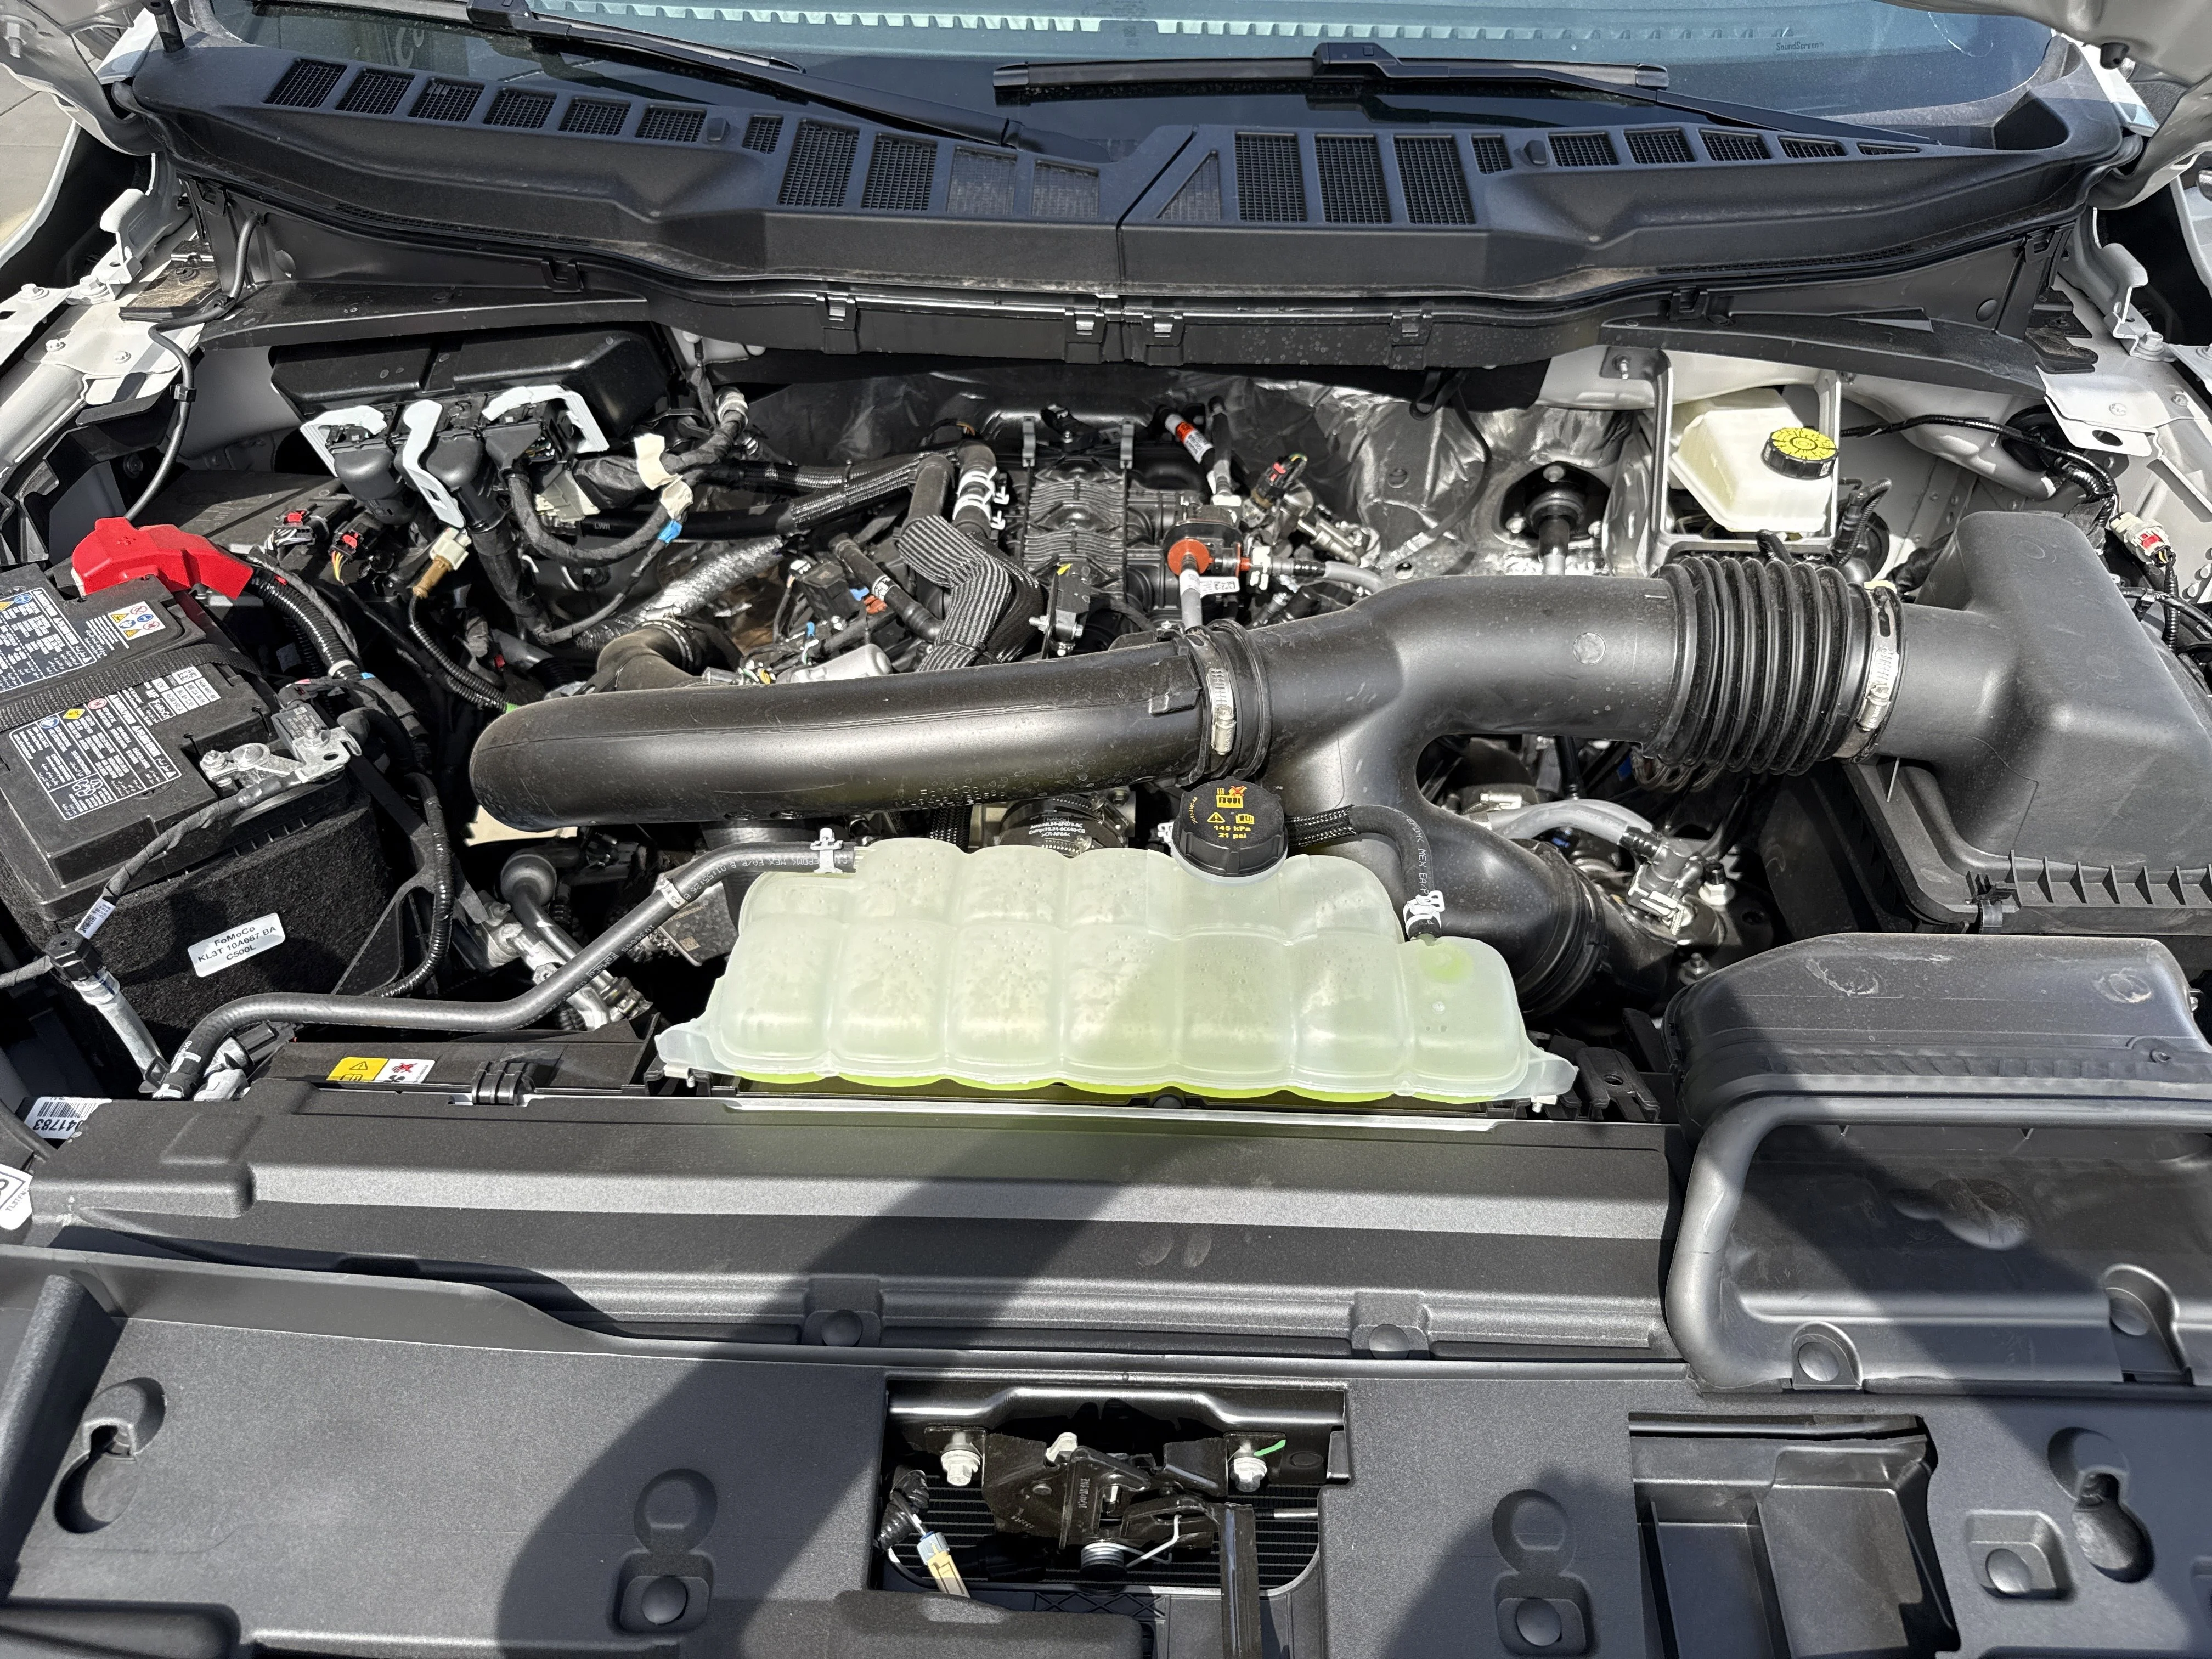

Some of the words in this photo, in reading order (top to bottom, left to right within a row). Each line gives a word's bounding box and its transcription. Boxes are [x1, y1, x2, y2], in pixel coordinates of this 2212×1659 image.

[768, 857, 786, 866] MEX
[1418, 848, 1427, 868] MEX
[690, 865, 727, 894] 01:55:26
[198, 947, 223, 962] KL3T
[226, 933, 260, 951] 10A687
[262, 926, 277, 936] BA
[214, 927, 256, 946] FoMoCo
[226, 945, 257, 960] C500L
[180, 1040, 193, 1052] RAD
